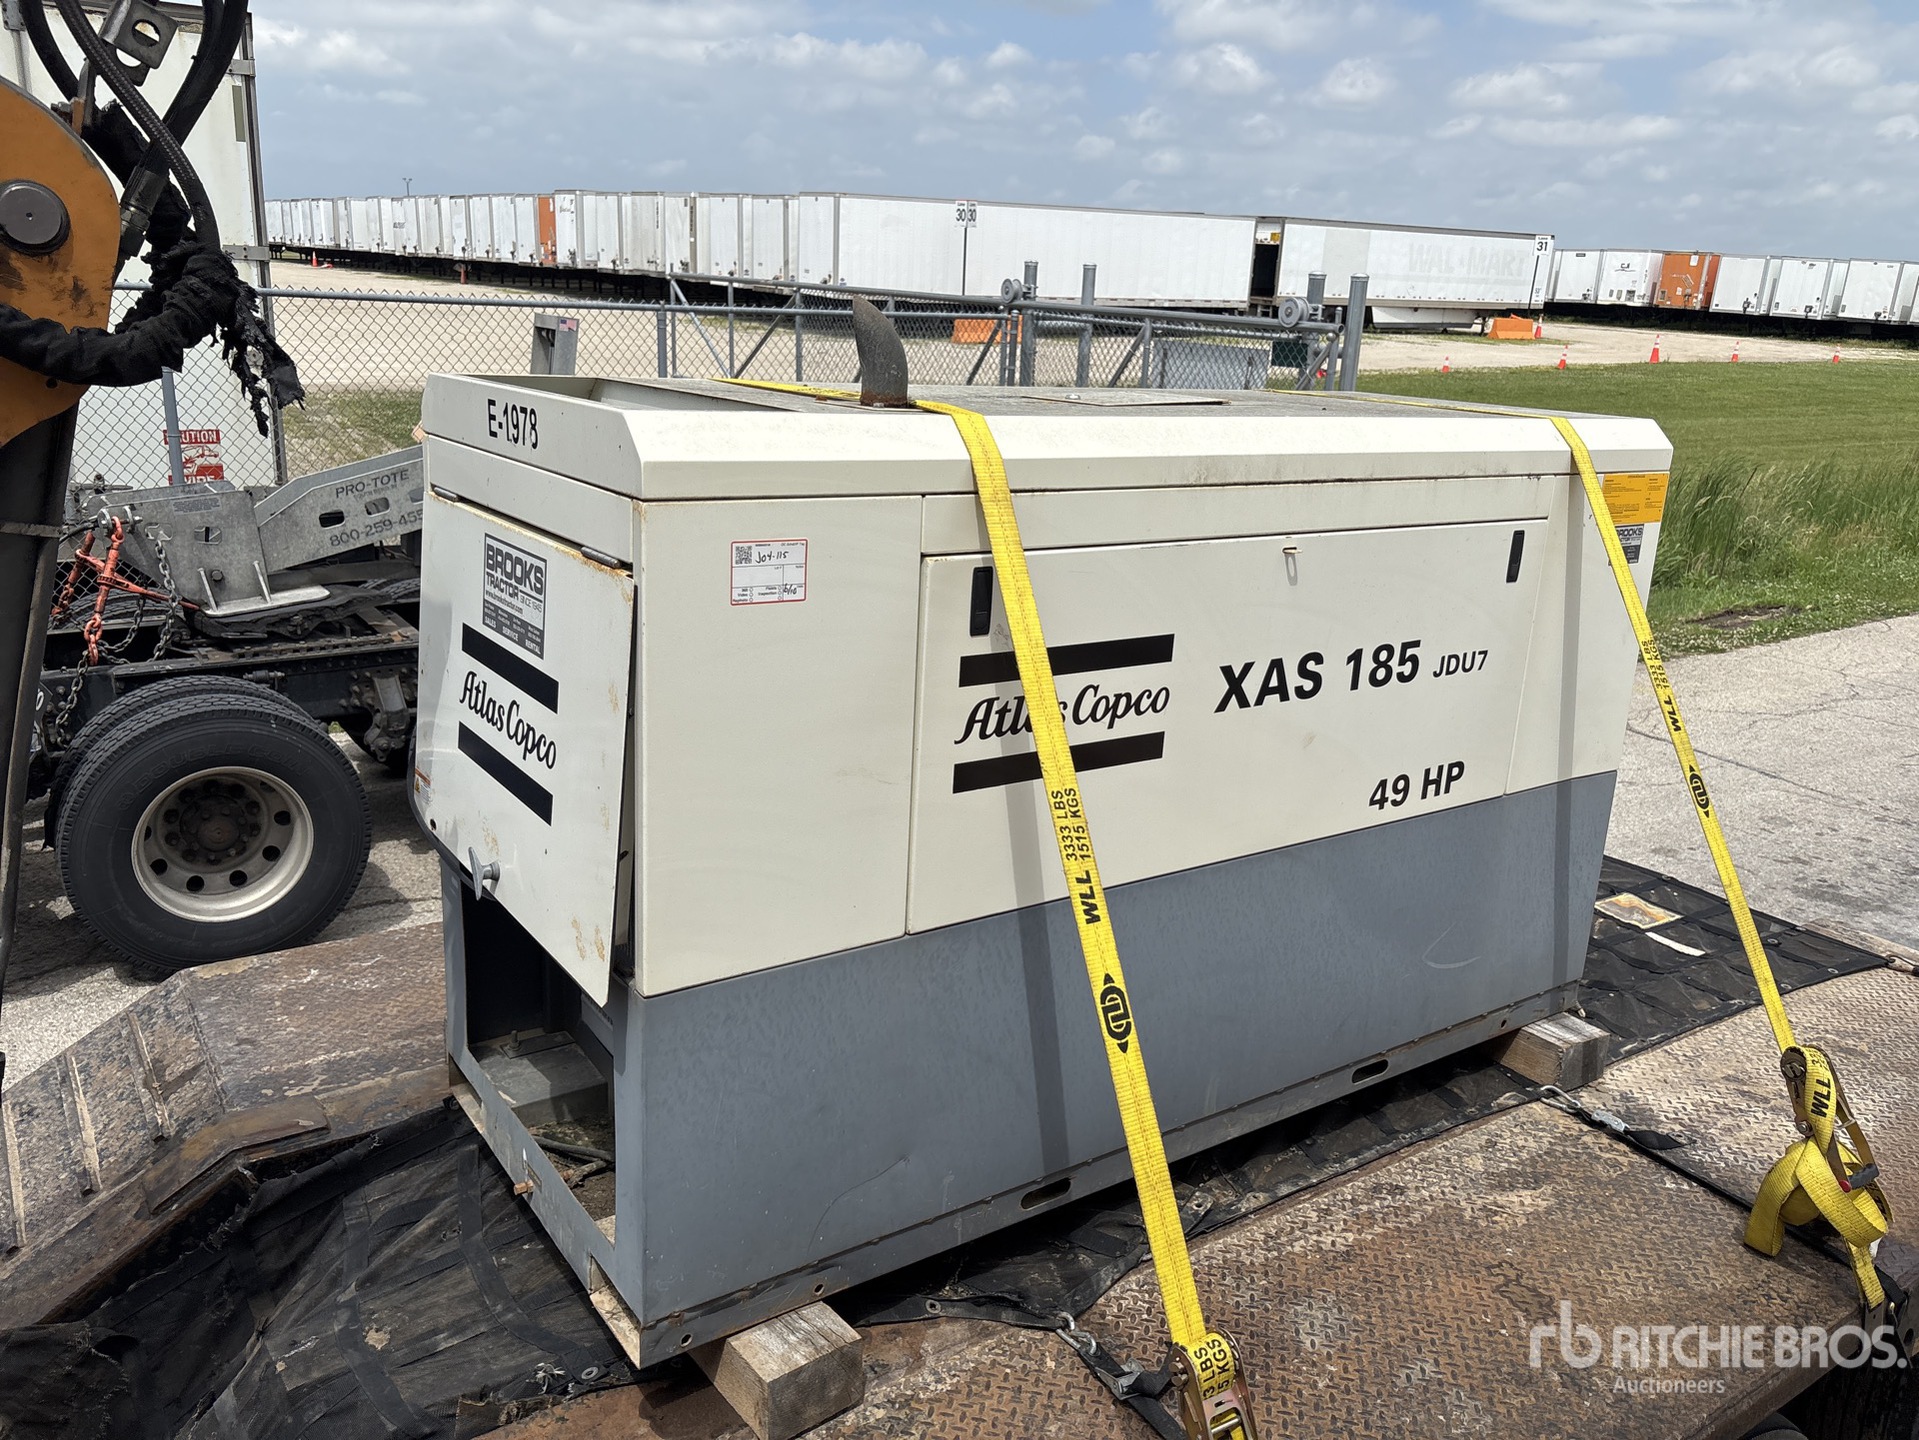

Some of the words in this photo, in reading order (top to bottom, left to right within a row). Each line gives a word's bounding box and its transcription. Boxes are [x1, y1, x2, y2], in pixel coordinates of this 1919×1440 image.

[1536, 241, 1548, 252] 31
[487, 398, 539, 450] E-1978
[335, 468, 410, 499] PRO-TOTE
[486, 543, 544, 596] BROOKS
[486, 571, 519, 601] TRACTOR
[1213, 651, 1325, 713] XAS
[1346, 640, 1422, 692] 185
[1433, 650, 1489, 678] JDU7
[459, 670, 506, 732] Atlas
[506, 699, 557, 770] Copco
[1072, 684, 1171, 730] Copco
[1663, 694, 1682, 732] WLL
[1051, 790, 1069, 819] LBS
[1064, 787, 1082, 819] KGS
[1368, 773, 1411, 811] 49
[1420, 760, 1465, 800] HP
[1059, 825, 1078, 862] 3333
[1072, 825, 1092, 861] 1515
[1075, 869, 1102, 925] WLL
[1811, 1077, 1832, 1118] WLL
[1194, 1347, 1215, 1383] LBS
[1206, 1338, 1230, 1376] KGS
